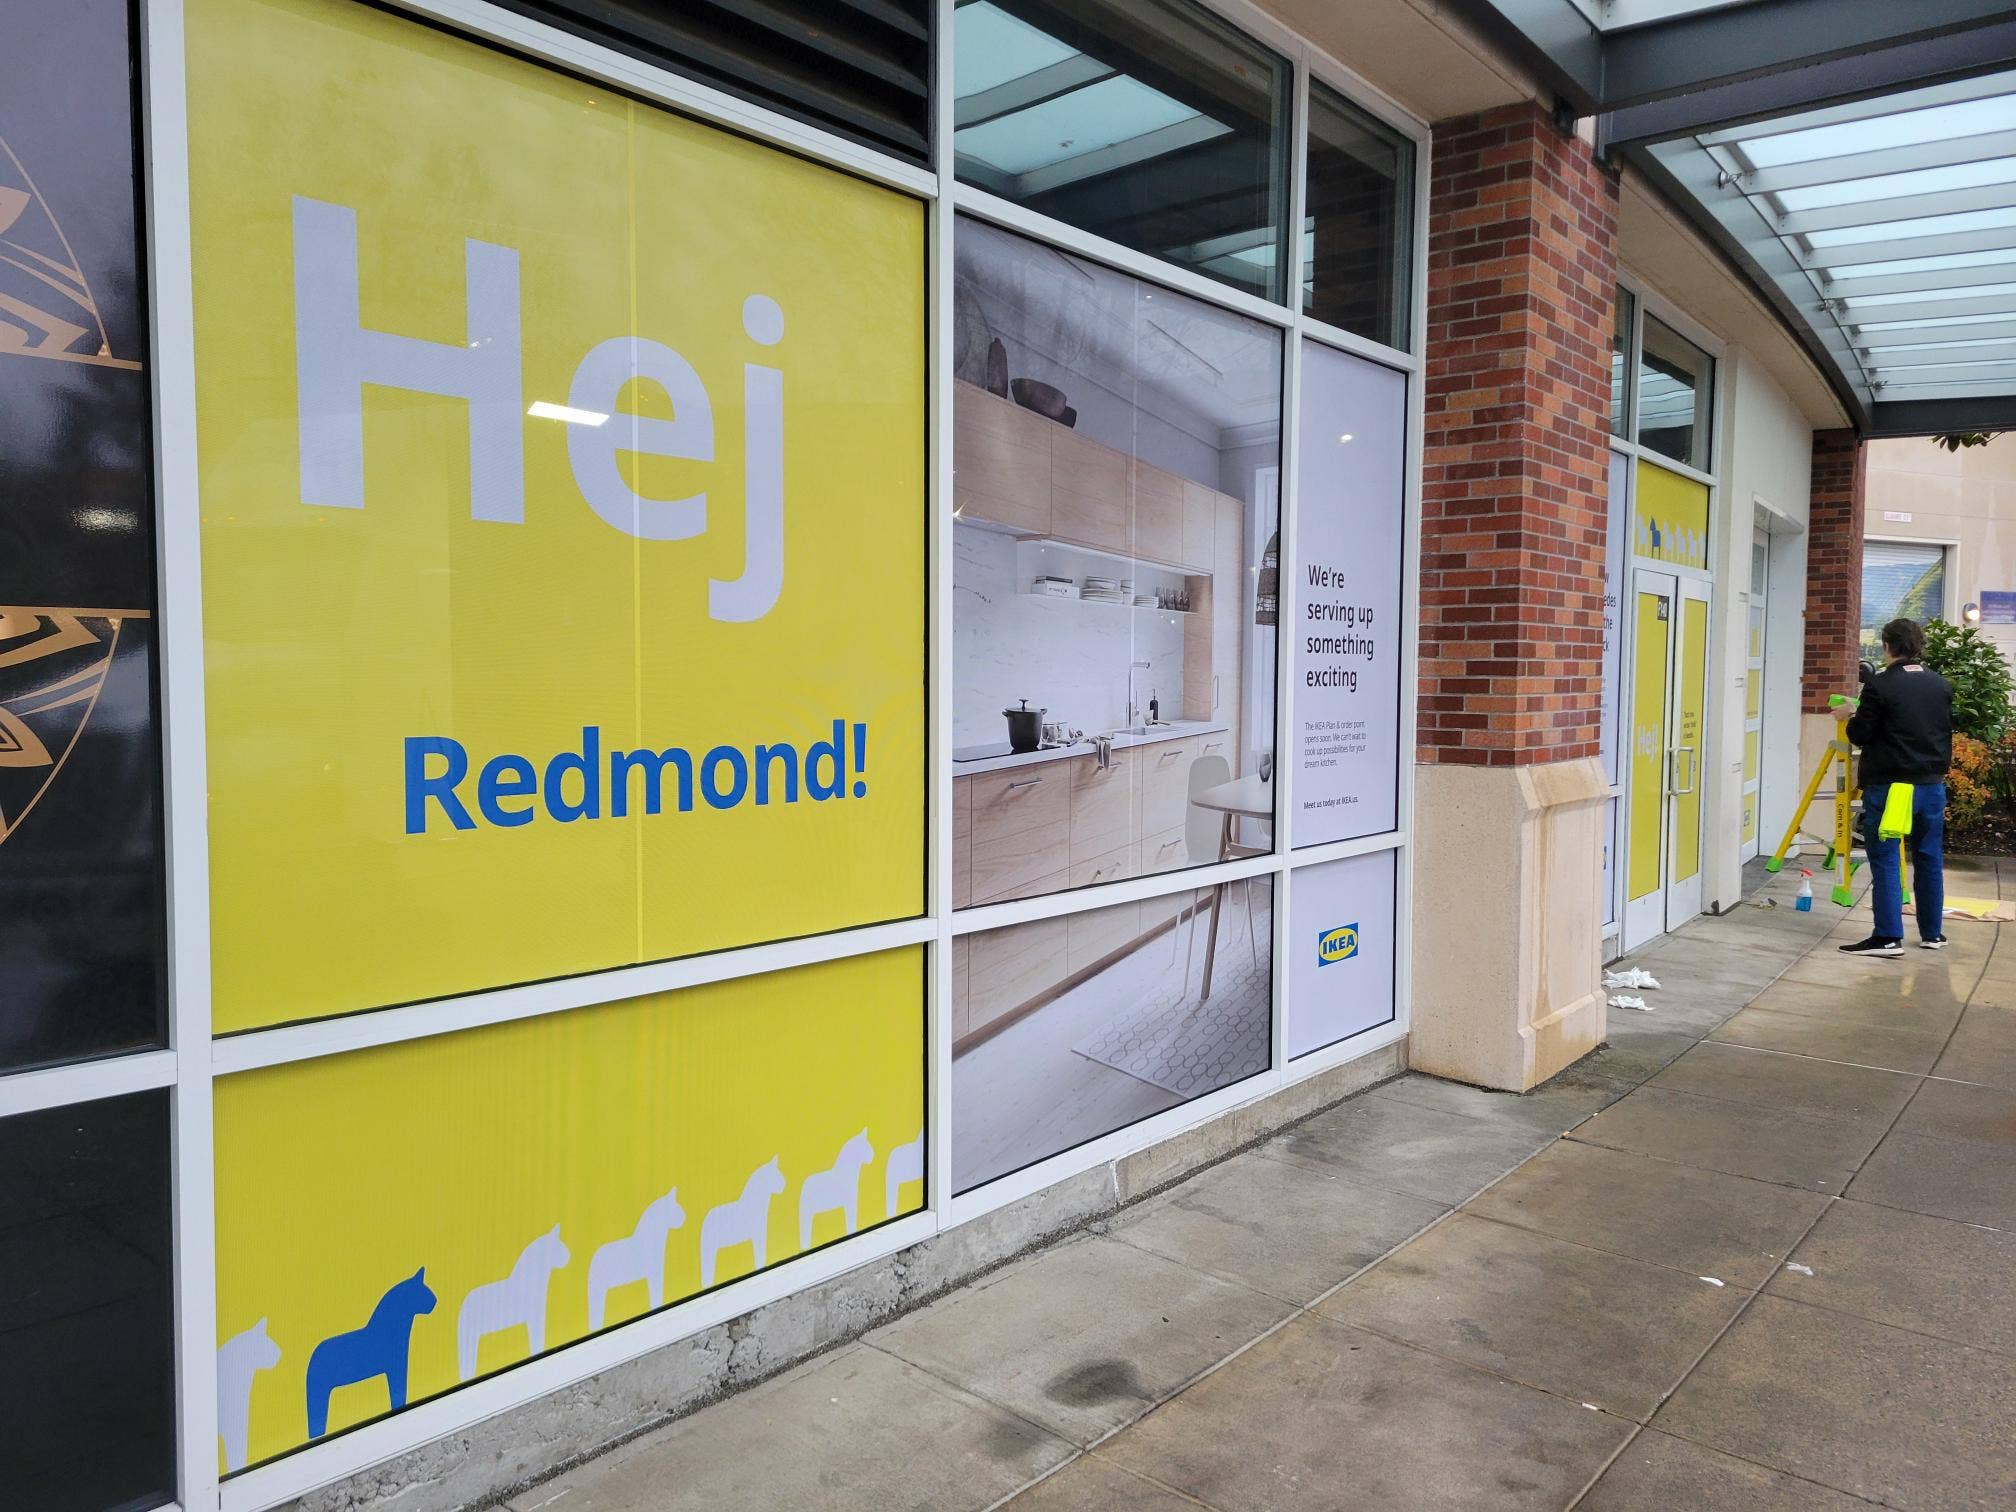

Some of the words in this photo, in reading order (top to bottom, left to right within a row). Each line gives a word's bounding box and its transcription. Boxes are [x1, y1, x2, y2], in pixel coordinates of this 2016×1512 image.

[292, 194, 785, 623] Hej
[1307, 564, 1345, 588] We're
[1307, 600, 1355, 628] serving
[1358, 607, 1374, 629] up
[1306, 633, 1374, 661] something
[1306, 665, 1357, 693] exciting
[1305, 722, 1314, 730] The
[1315, 721, 1325, 730] IKEA
[1326, 721, 1335, 730] Plan
[1341, 721, 1353, 729] order
[1304, 735, 1318, 745] opens
[1333, 733, 1340, 741] We
[1304, 746, 1315, 756] cook
[1324, 745, 1349, 756] possibilities
[1356, 744, 1367, 754] your
[1304, 760, 1320, 768] dream
[404, 718, 867, 835] Redmond!
[1303, 800, 1316, 809] Meet
[1322, 797, 1336, 808] today
[1322, 933, 1355, 955] IKEA
